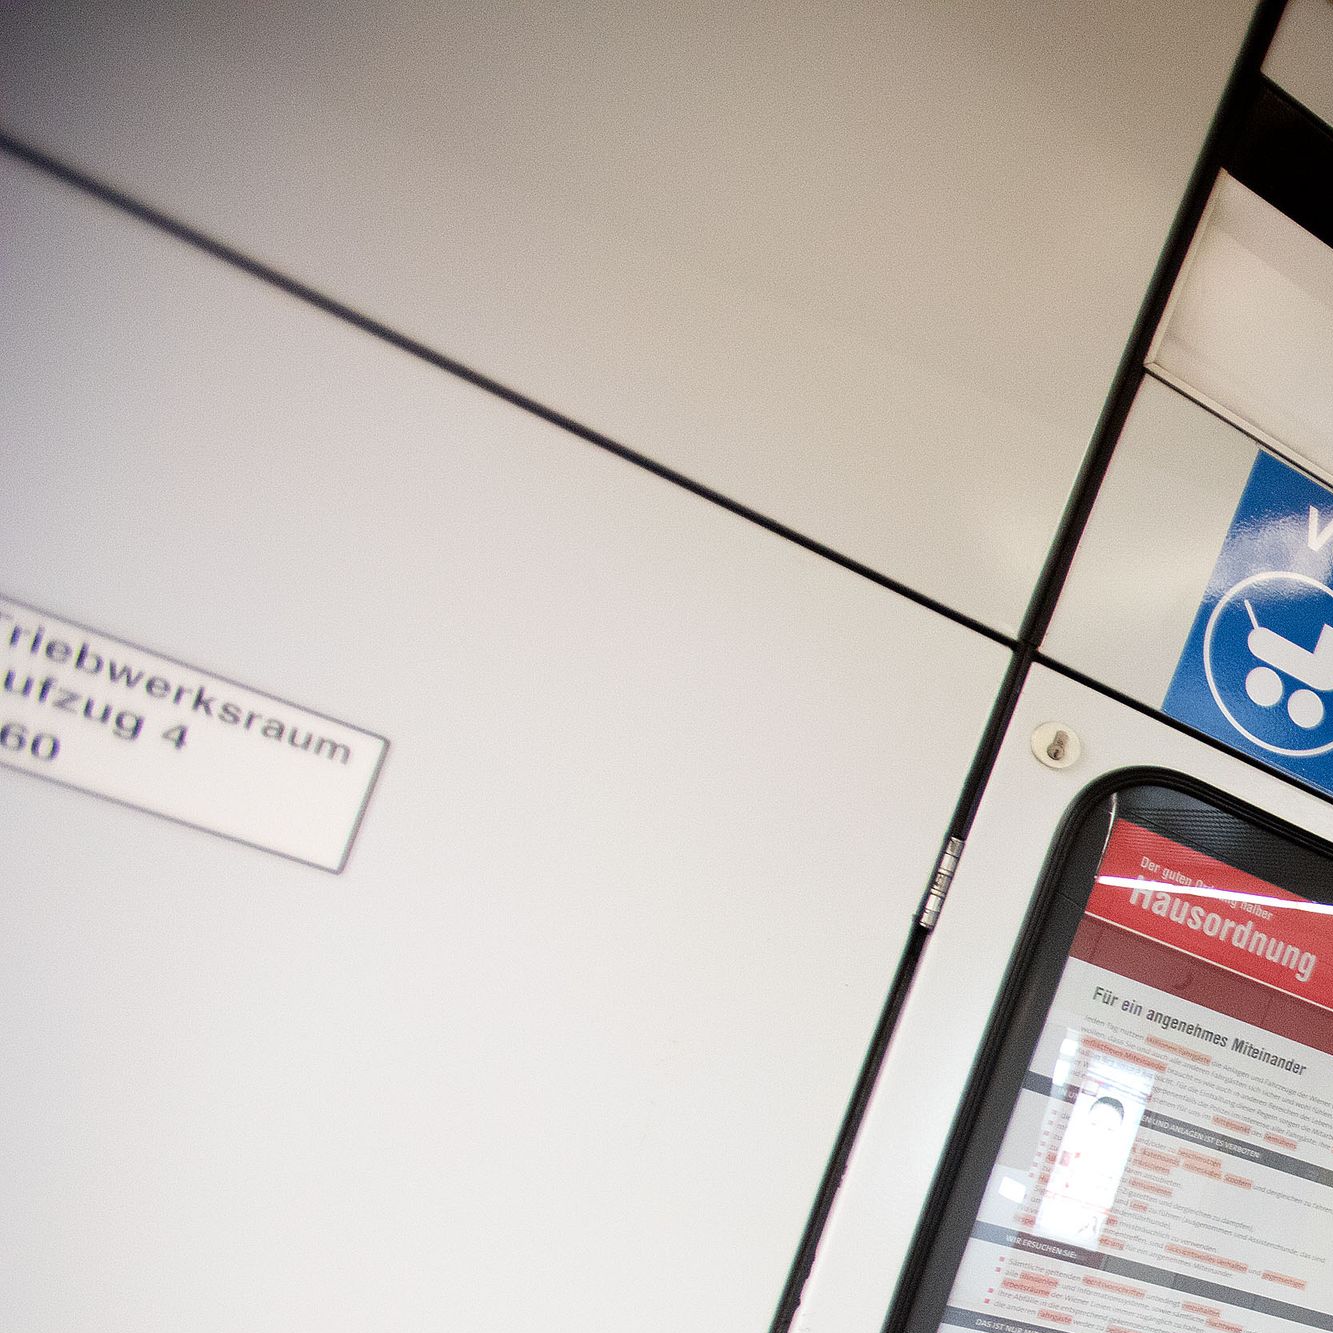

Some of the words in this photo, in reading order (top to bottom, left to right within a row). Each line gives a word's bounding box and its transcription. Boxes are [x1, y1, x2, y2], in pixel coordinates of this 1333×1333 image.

[3, 668, 145, 742] ufzug
[162, 723, 189, 751] 4
[1139, 855, 1161, 874] Der
[1161, 866, 1193, 889] guten
[1125, 873, 1319, 984] Hausordnung
[1091, 984, 1120, 1007] Für
[1120, 996, 1144, 1016] ein
[1144, 1005, 1230, 1051] angenehmes
[1230, 1036, 1308, 1076] Miteinander
